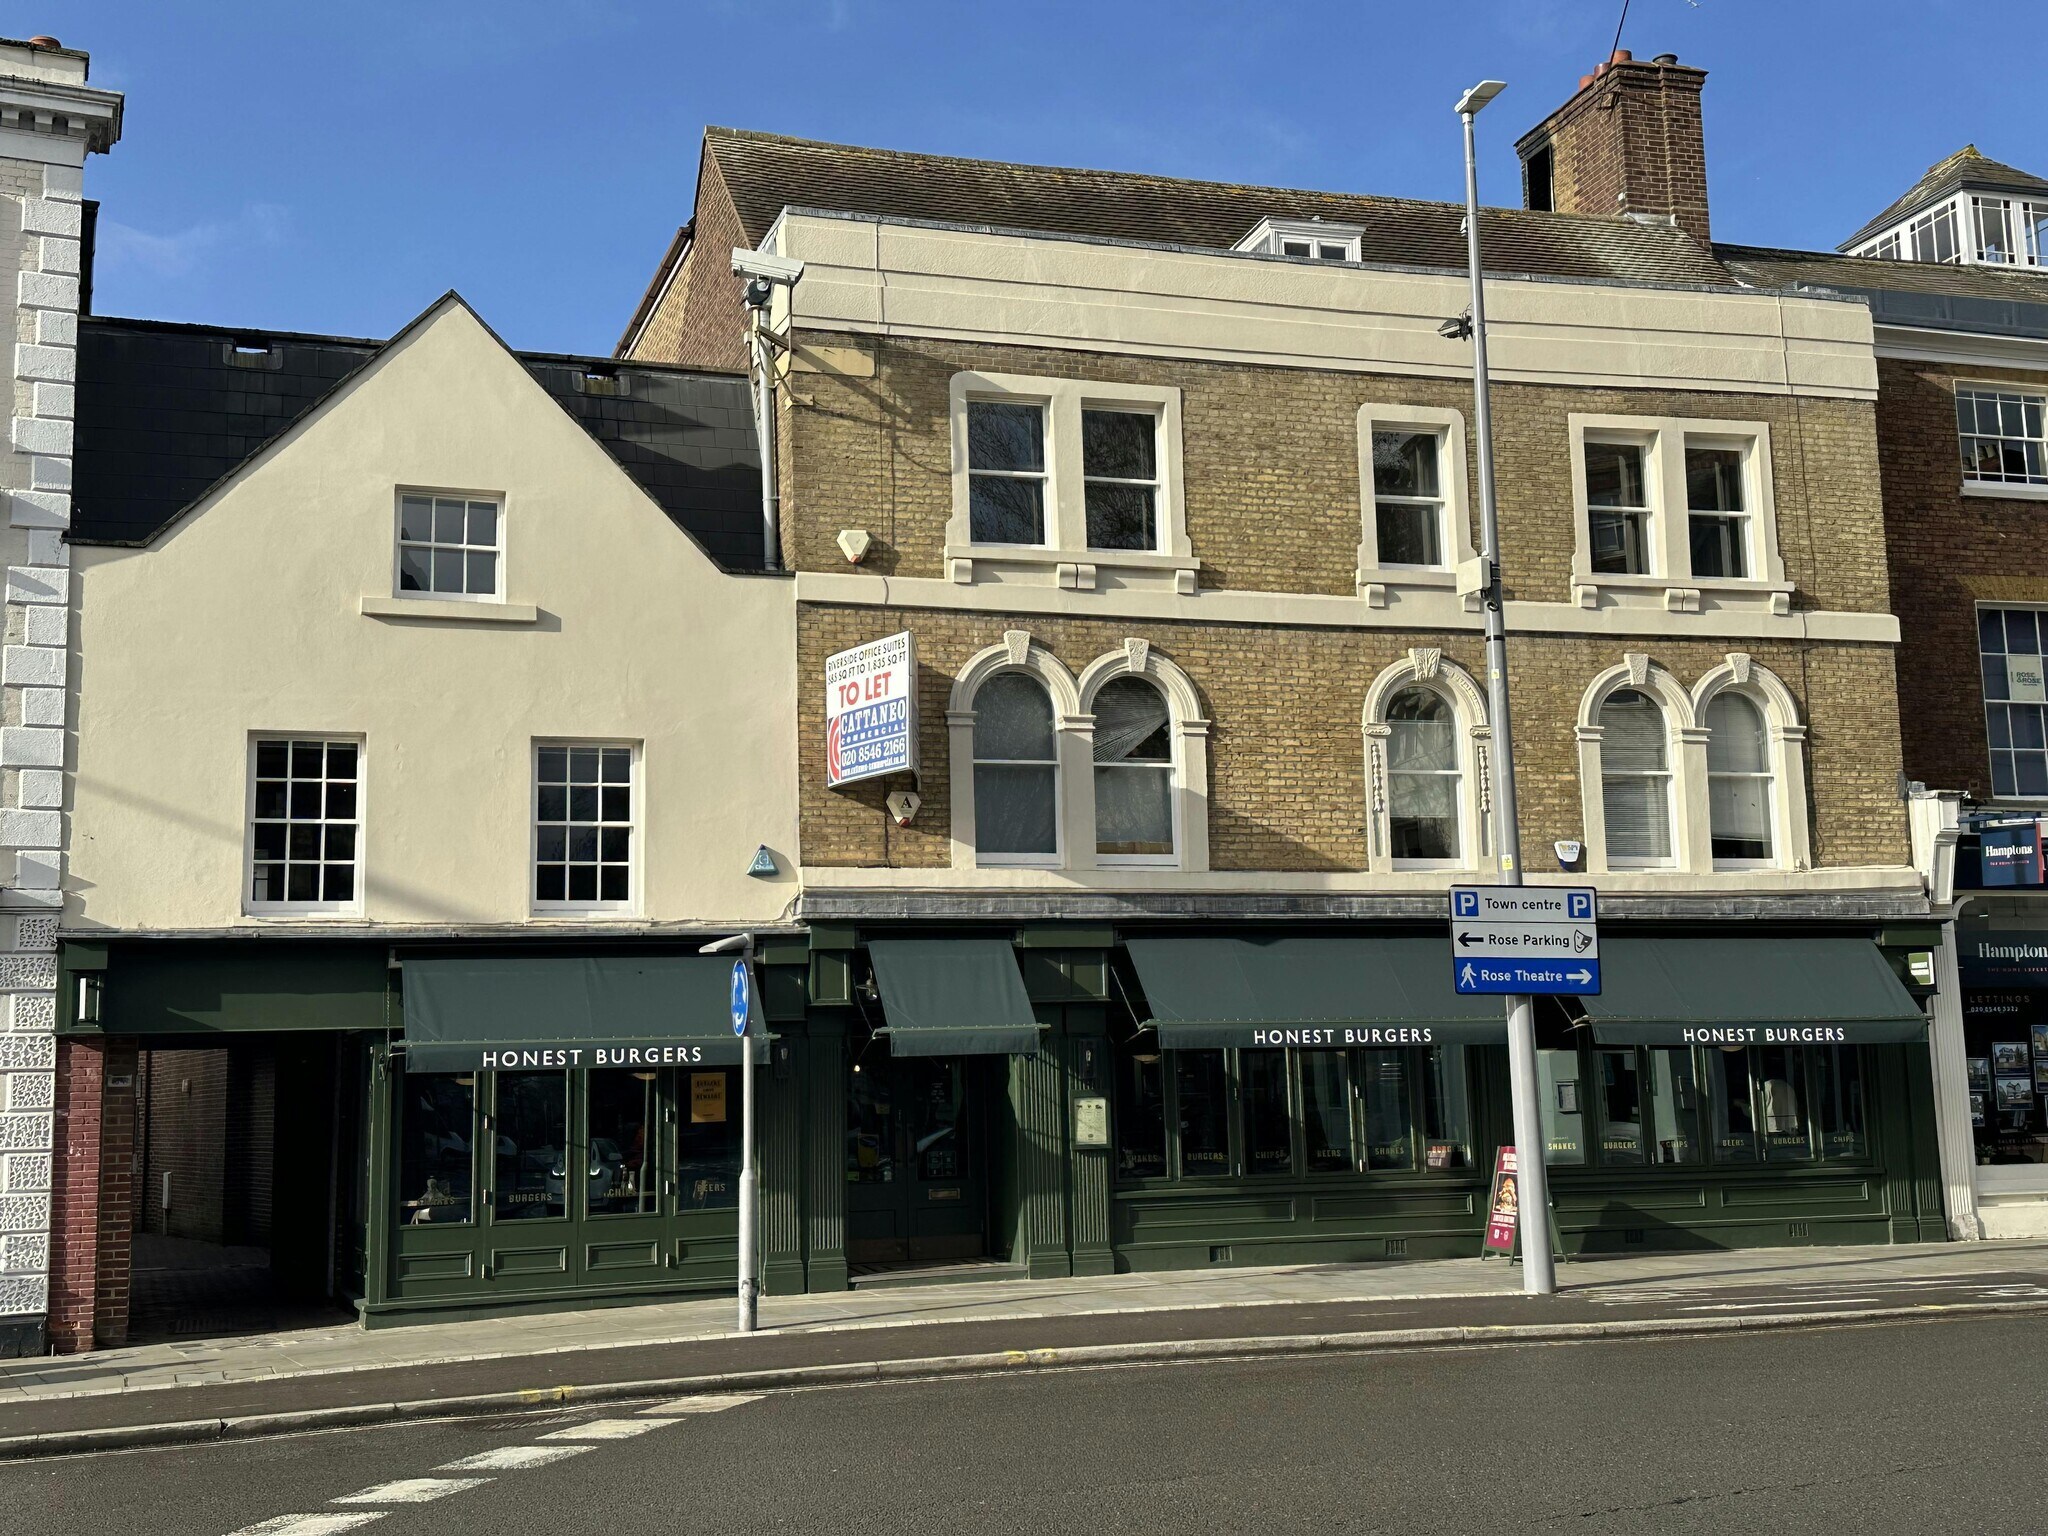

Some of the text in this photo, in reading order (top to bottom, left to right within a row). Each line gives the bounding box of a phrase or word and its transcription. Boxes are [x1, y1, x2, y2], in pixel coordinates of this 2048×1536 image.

[829, 637, 905, 671] RIVERSIDE OFFICE SUITES
[838, 669, 847, 681] SQ
[848, 666, 855, 678] FT
[856, 663, 866, 675] TO
[887, 653, 897, 666] SQ
[899, 650, 906, 662] FT
[839, 671, 892, 708] TO LET
[841, 699, 906, 735] CATTANEO
[841, 722, 906, 745] COMMERCIAL
[841, 737, 906, 767] 020 8546 2166
[1985, 845, 2033, 858] Hamptons
[1459, 893, 1588, 917] P Town centre P
[1488, 934, 1570, 948] Rose Parking
[1481, 969, 1563, 982] Rose Theatre
[1969, 995, 2031, 1003] LETTINGS
[1254, 1028, 1432, 1044] HONEST BURGERS
[1684, 1027, 1845, 1042] HONEST BURGERS
[482, 1047, 702, 1067] HONEST BURGERS
[508, 1192, 553, 1203] BURGERS
